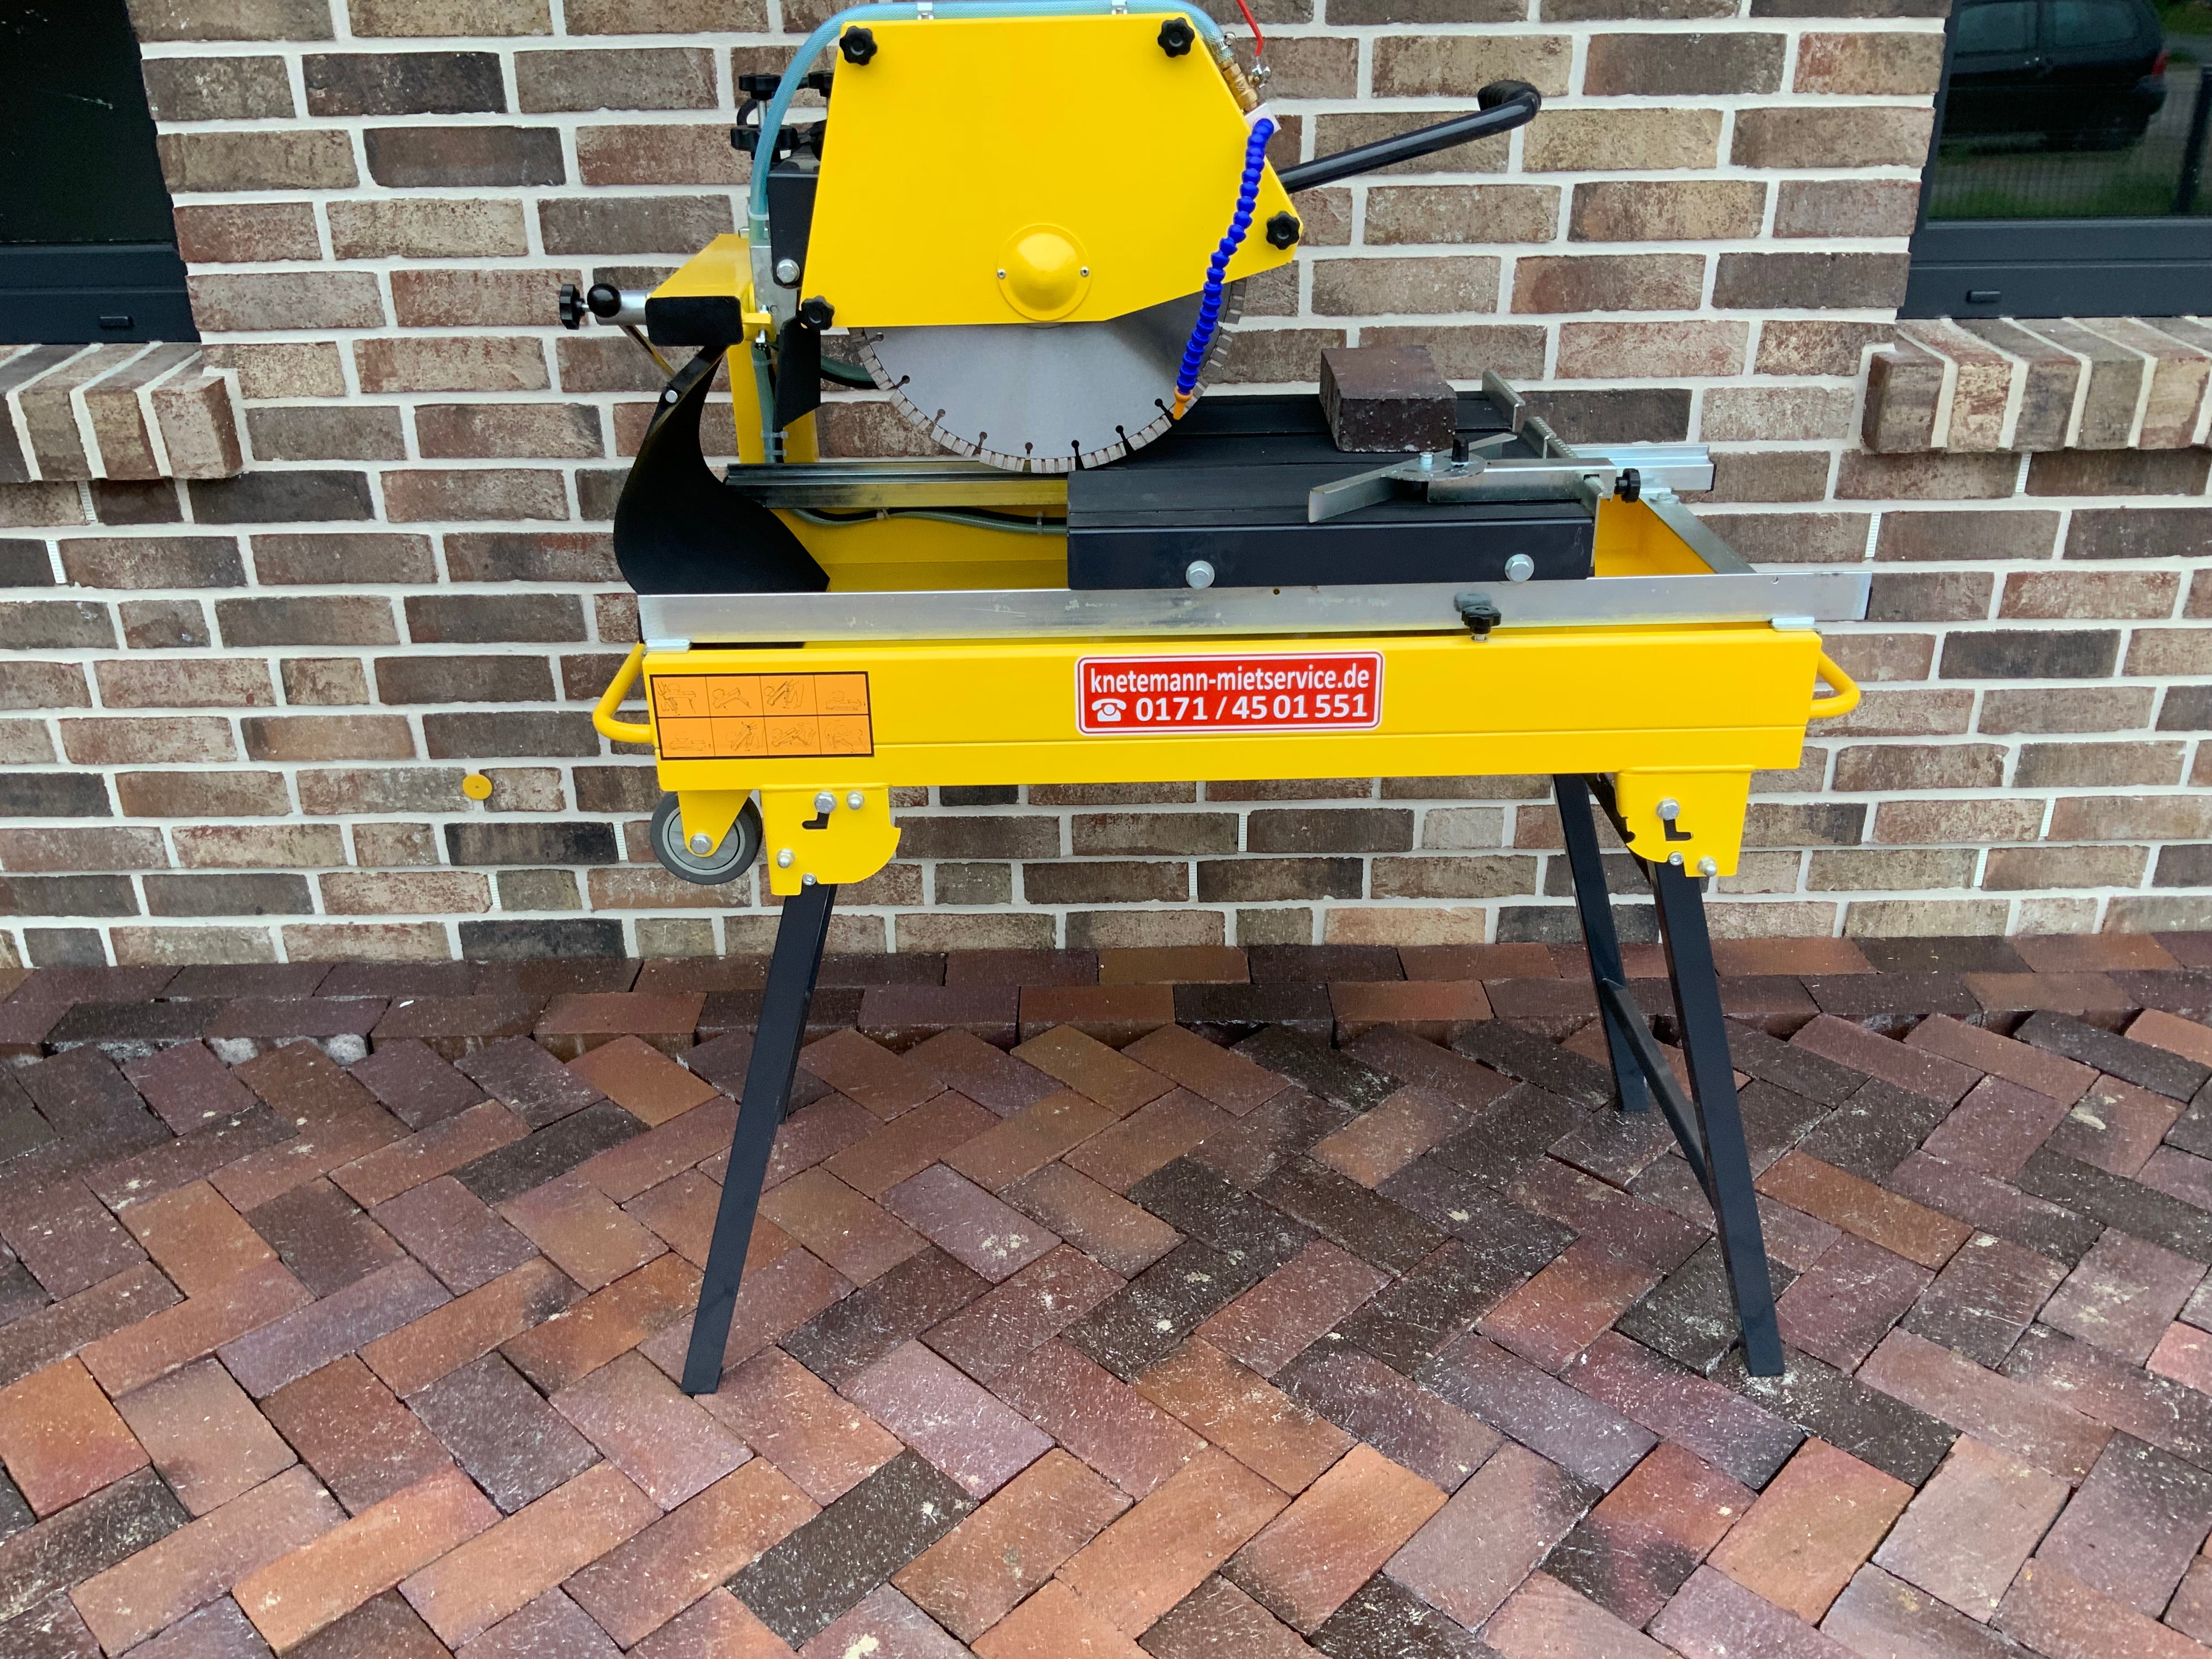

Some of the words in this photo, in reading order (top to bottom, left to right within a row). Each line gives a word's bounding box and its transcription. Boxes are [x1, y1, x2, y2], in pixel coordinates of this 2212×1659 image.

[1090, 662, 1370, 693] knetemann-mietservice.de
[1135, 696, 1209, 722] 0171
[1314, 693, 1368, 718] 551
